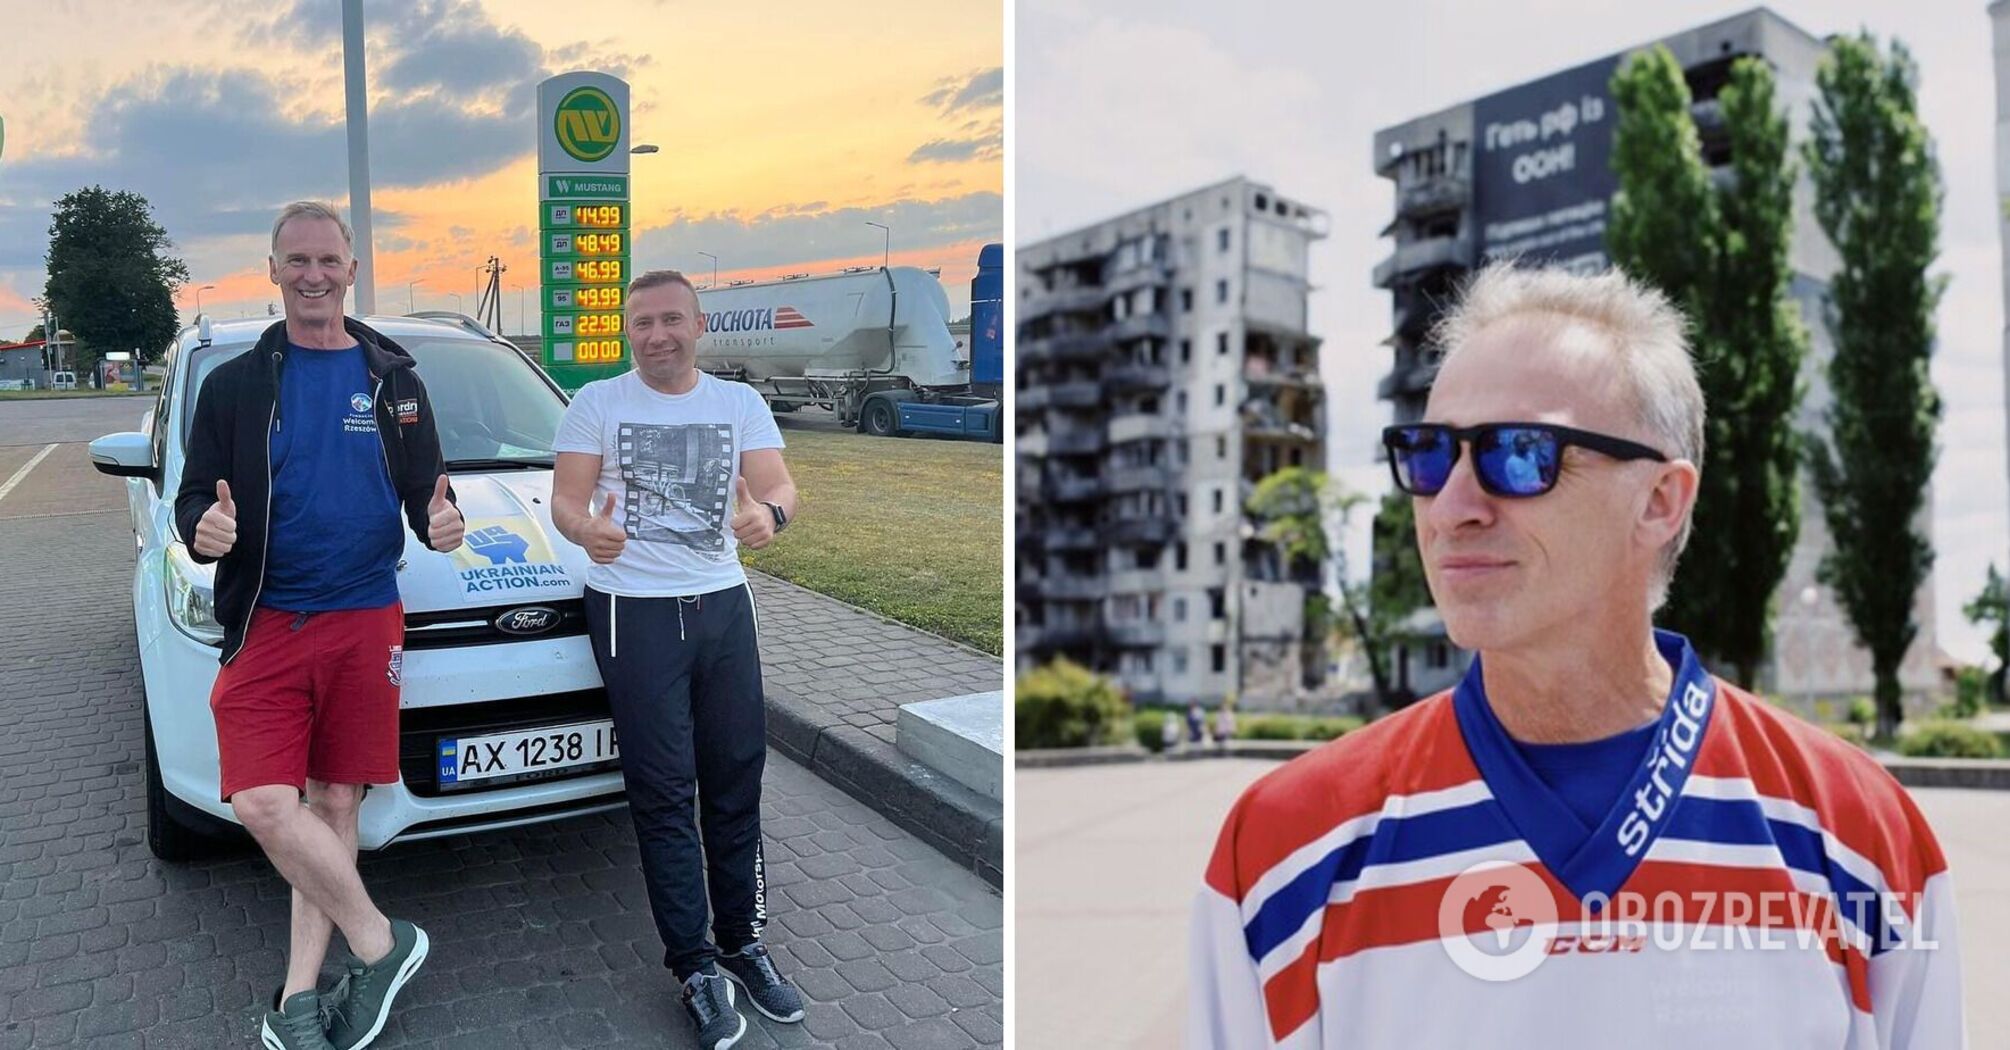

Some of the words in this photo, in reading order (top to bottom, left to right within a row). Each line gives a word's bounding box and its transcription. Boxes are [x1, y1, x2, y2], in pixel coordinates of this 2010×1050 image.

[575, 183, 622, 193] MUSTANG
[577, 234, 620, 252] 48.49
[578, 261, 620, 279] 46.99
[578, 288, 620, 306] 49.99
[579, 315, 621, 333] 22.98
[713, 336, 775, 348] transport
[461, 564, 565, 581] UKRAINIAN
[467, 576, 571, 593] ACTION.com
[511, 611, 548, 629] Ford
[461, 741, 506, 775] AX
[516, 732, 583, 767] 1238
[442, 768, 456, 777] UA
[1617, 682, 1708, 857] střída
